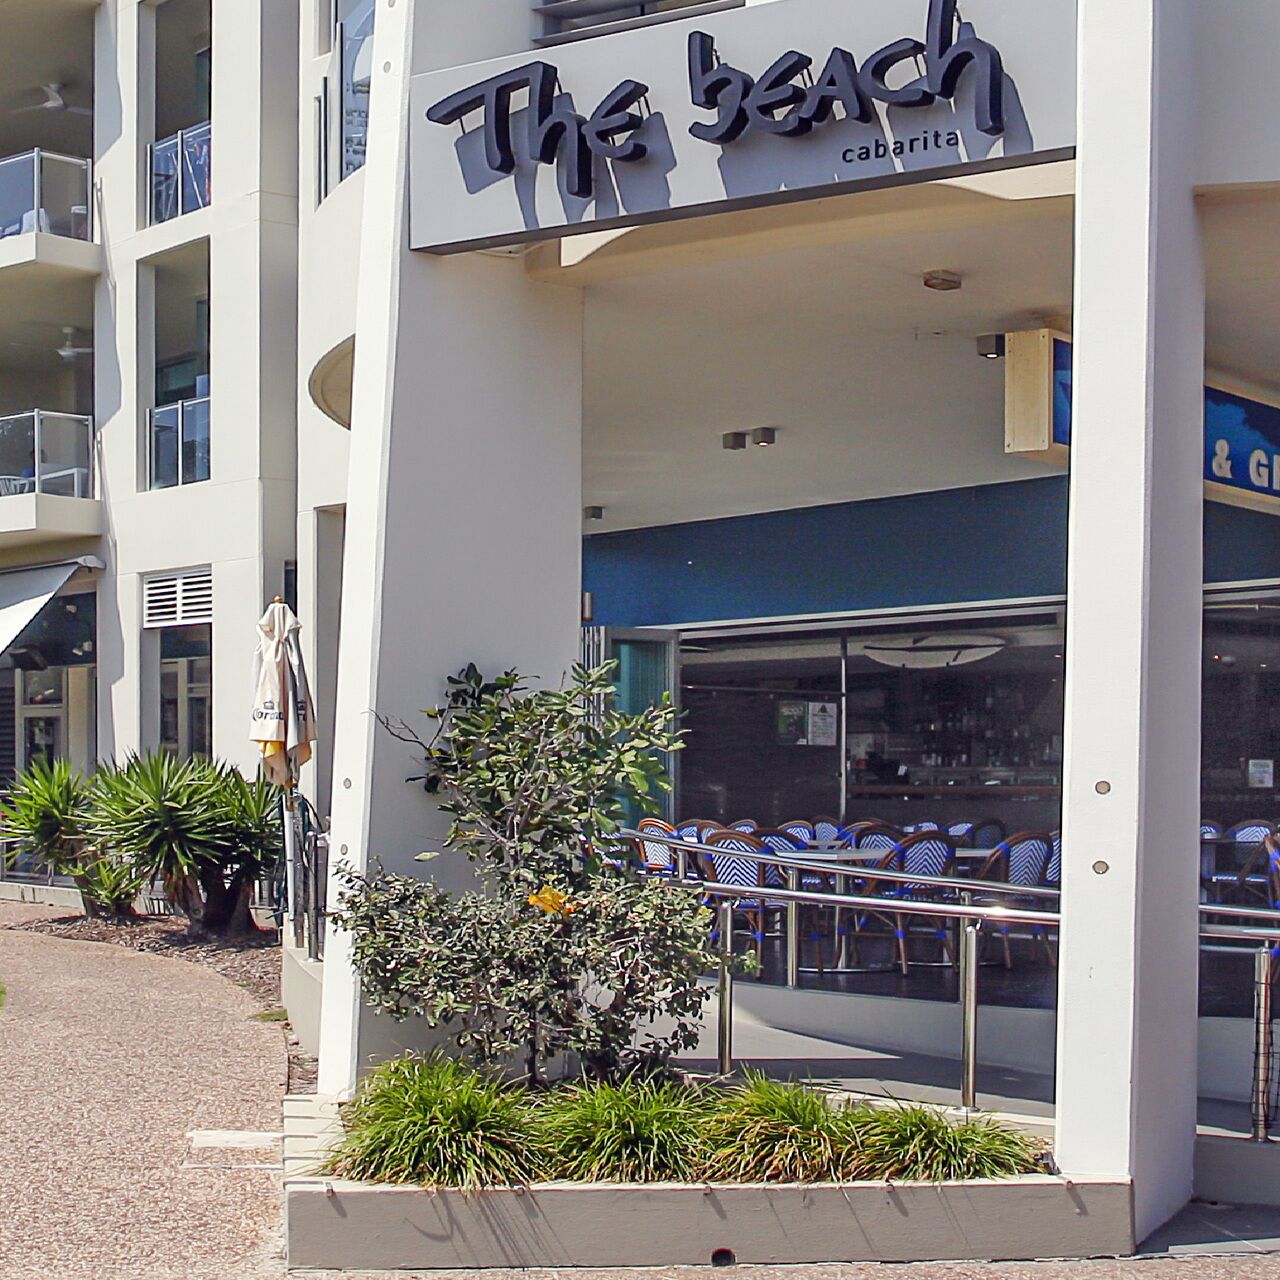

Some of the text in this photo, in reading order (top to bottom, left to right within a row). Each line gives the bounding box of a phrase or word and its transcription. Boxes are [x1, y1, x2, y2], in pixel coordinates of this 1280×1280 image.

[427, 60, 648, 198] The
[842, 130, 959, 163] cabarita
[1212, 438, 1232, 479] &
